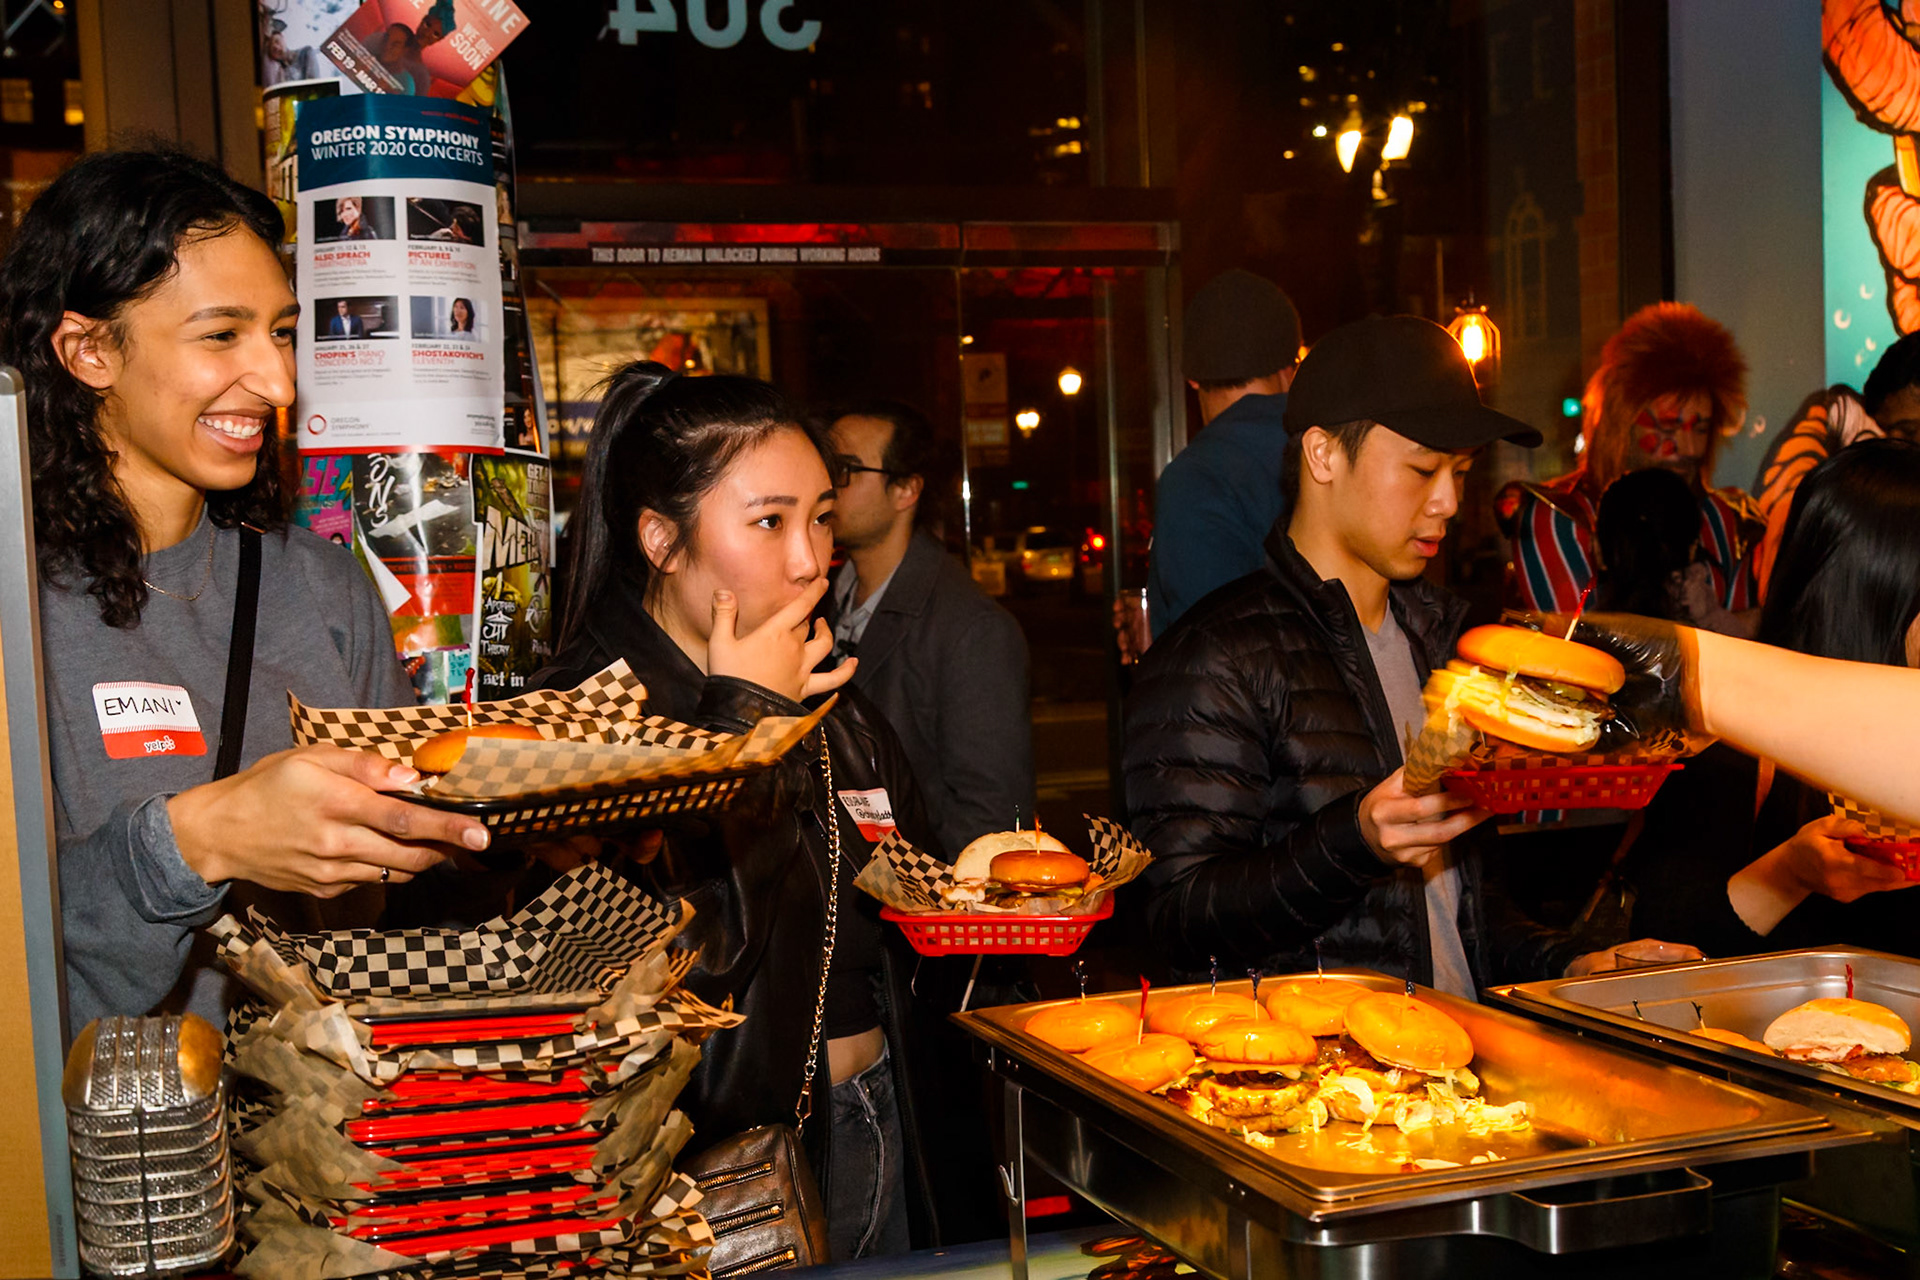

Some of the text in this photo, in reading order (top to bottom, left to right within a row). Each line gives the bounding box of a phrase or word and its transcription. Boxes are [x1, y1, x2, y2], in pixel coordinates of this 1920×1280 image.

[462, 21, 495, 59] WE DIE
[449, 32, 485, 71] SOON
[326, 41, 347, 61] FEB
[355, 69, 377, 93] MAR
[311, 125, 381, 145] OREGON
[384, 125, 480, 150] SYMPHONY
[311, 141, 367, 161] WINTER
[369, 141, 407, 156] 2020
[408, 142, 485, 166] CONCERTS
[408, 250, 451, 260] PICTURES
[591, 247, 881, 263] THIS DOOR TO REMAIN UNLOCKED DURING WORKING HOURS
[315, 350, 356, 360] CHOPIN'S
[104, 696, 176, 716] EMANI
[144, 739, 167, 754] yelp
